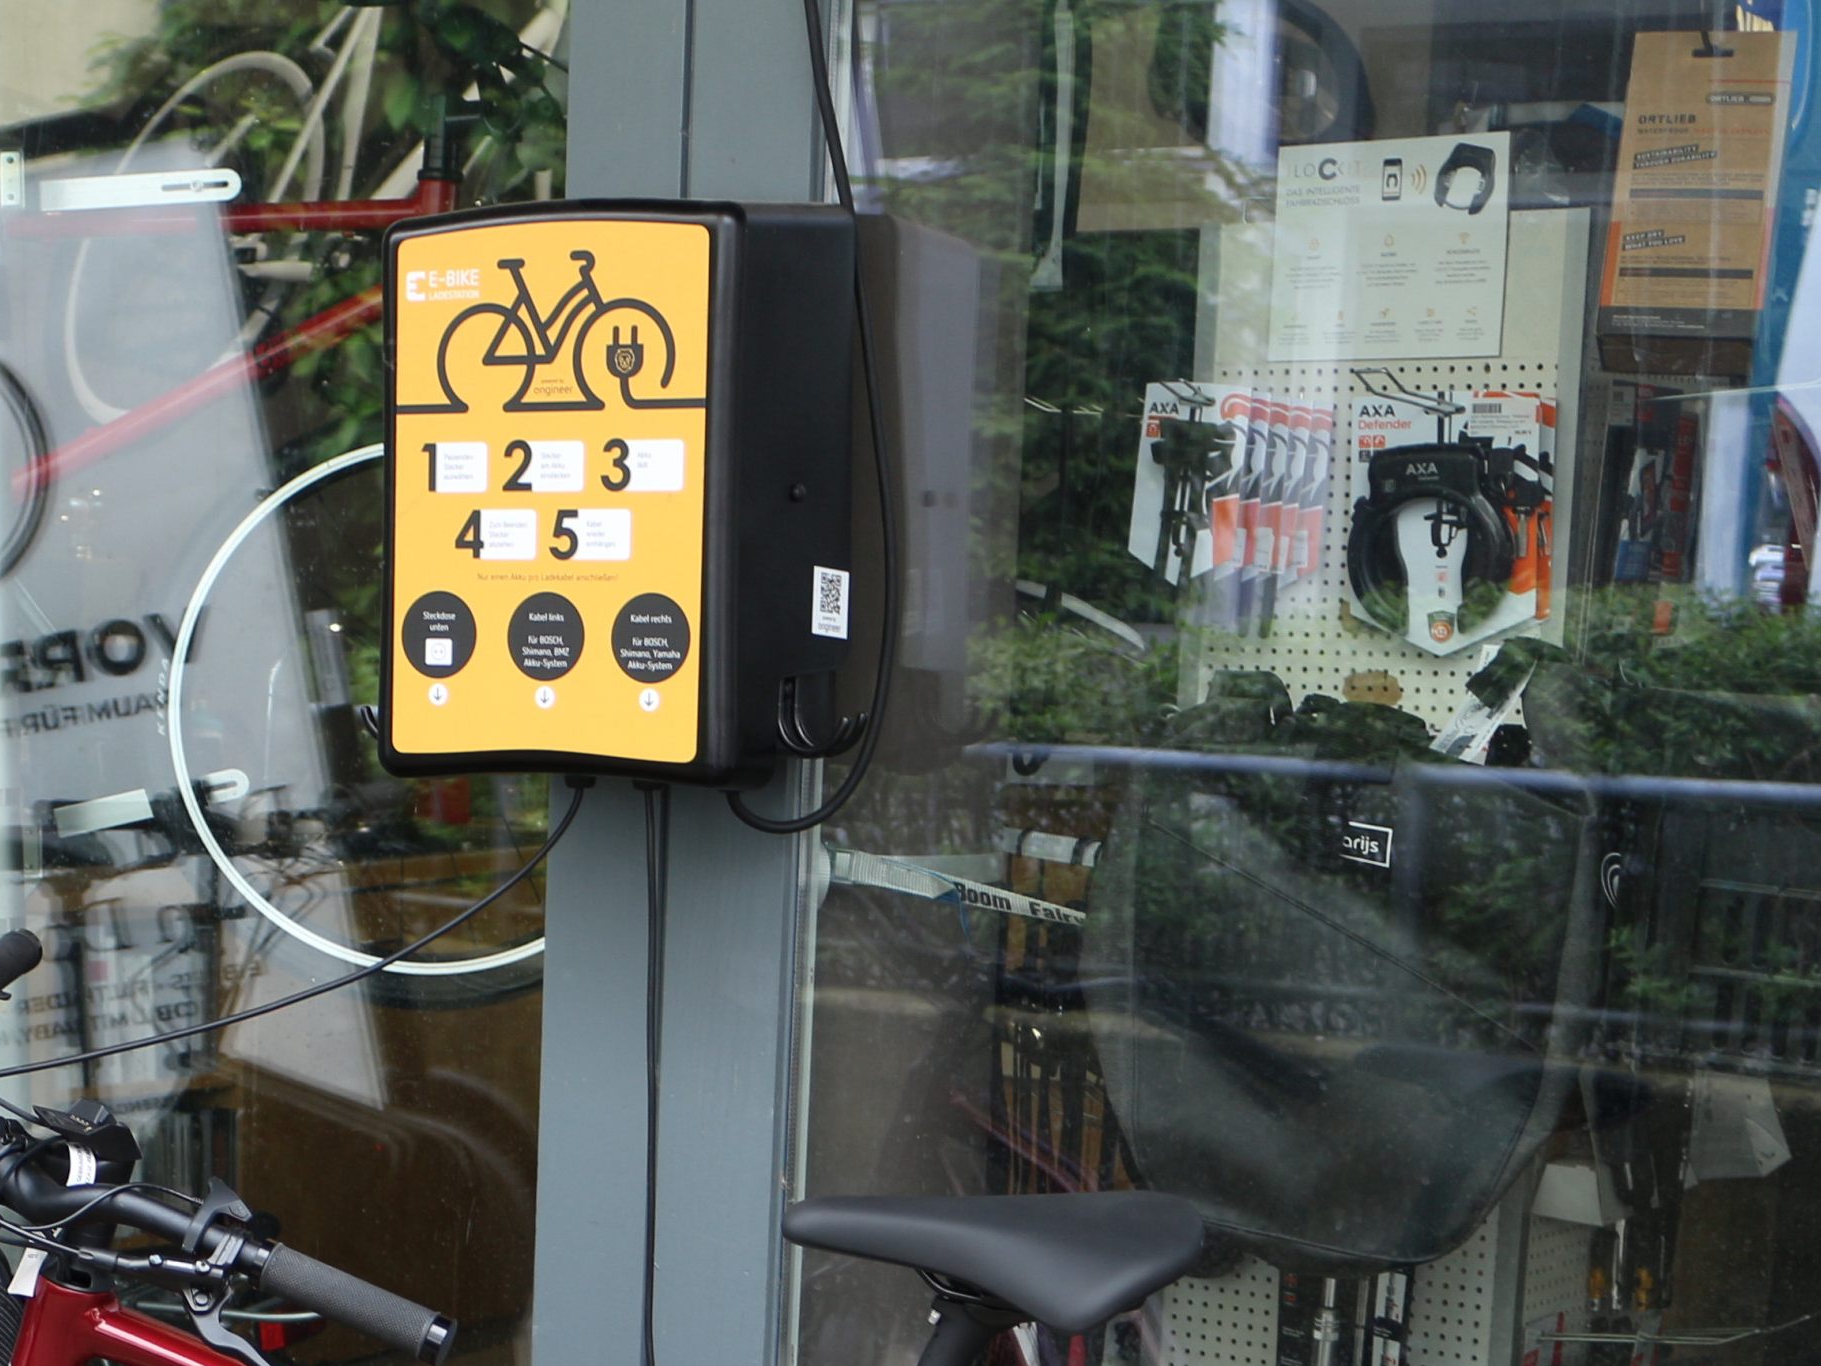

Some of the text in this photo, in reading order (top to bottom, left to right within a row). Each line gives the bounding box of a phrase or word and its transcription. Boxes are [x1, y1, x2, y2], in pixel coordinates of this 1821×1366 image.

[1639, 114, 1696, 124] ORTLIEB
[429, 269, 479, 287] E-BIKE
[429, 290, 480, 299] LADESTATION
[1149, 403, 1179, 415] AXA
[1359, 405, 1396, 417] AXA
[1358, 420, 1411, 430] Defender
[421, 443, 436, 492] 1
[502, 440, 532, 491] 2
[600, 438, 630, 491] 3
[1405, 464, 1438, 475] AXA
[455, 509, 484, 559] 4
[549, 509, 578, 560] 5
[423, 610, 456, 622] Steckdose
[528, 612, 564, 623] Kabel links
[630, 614, 672, 625] Kabel rechts
[429, 623, 449, 632] unten
[528, 635, 564, 646] für BOSCH,
[632, 637, 669, 649] für BOSCH,
[522, 646, 554, 657] Shimano,
[620, 648, 681, 660] Shimano, Yamaha
[523, 658, 568, 669] Akku-System
[627, 661, 673, 672] Akku-System
[155, 658, 168, 737] KENDA
